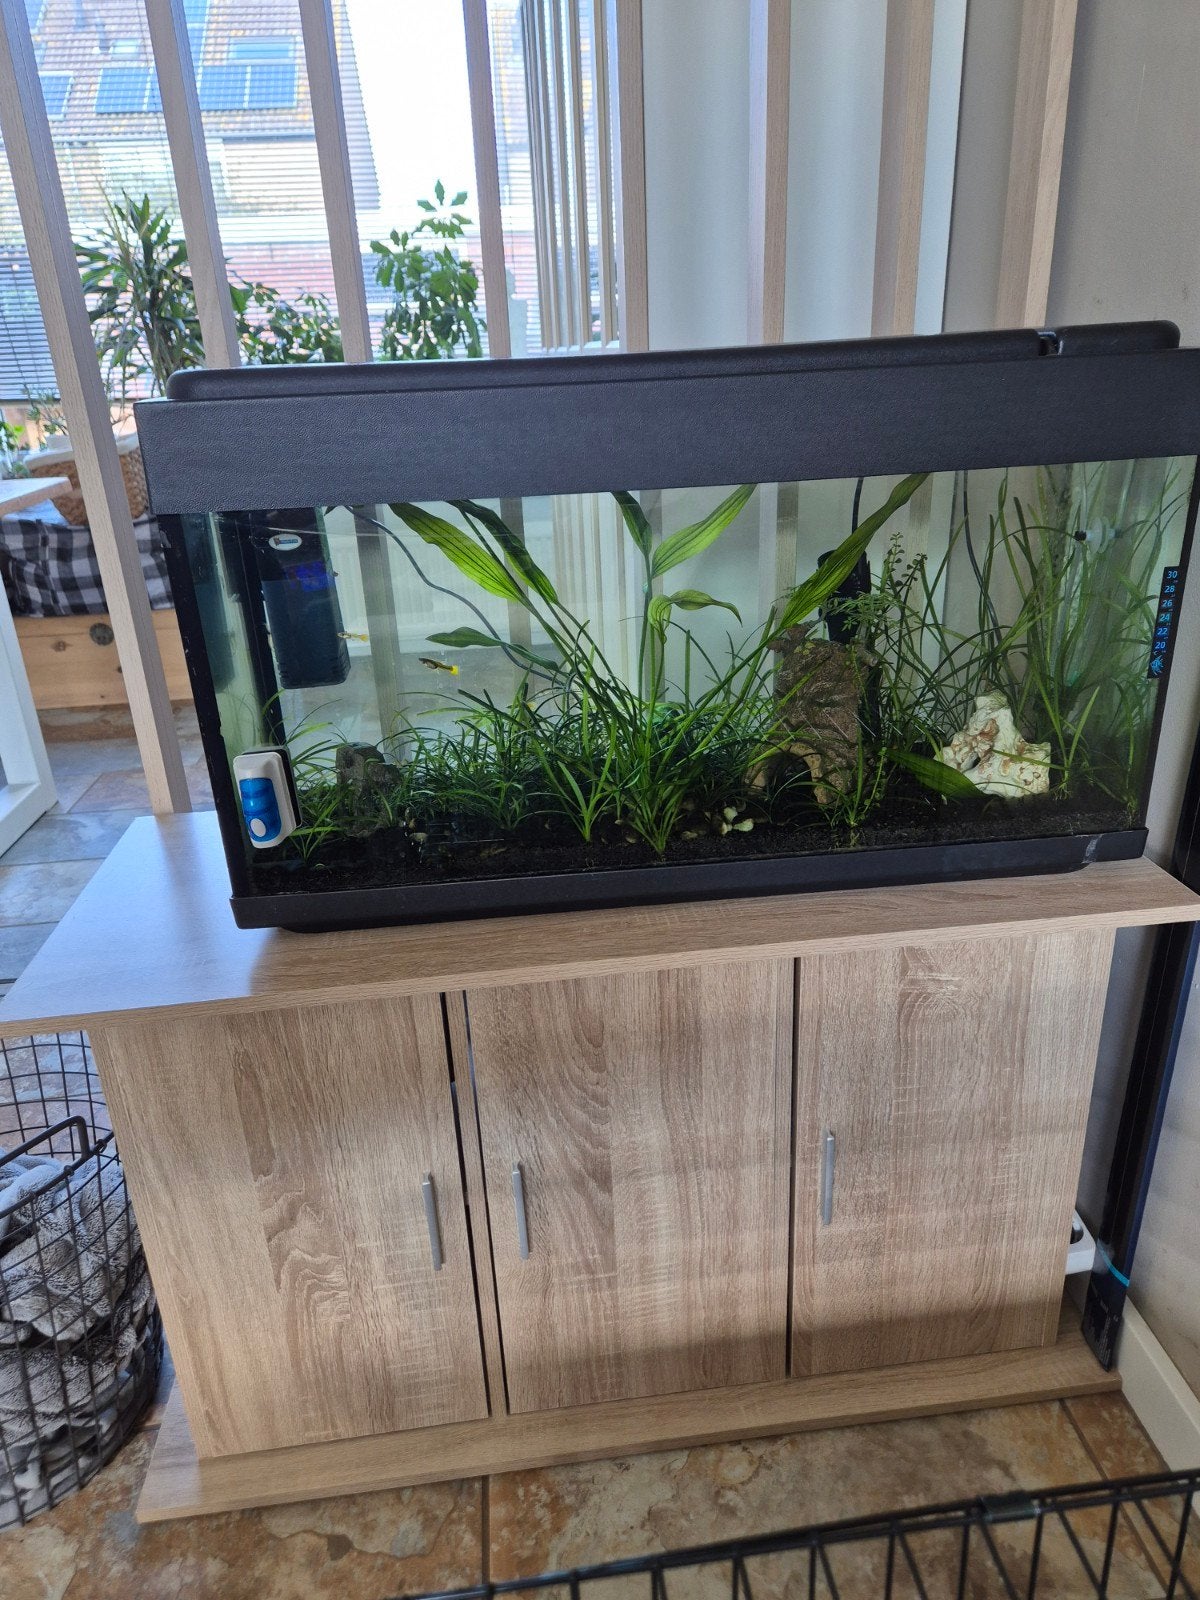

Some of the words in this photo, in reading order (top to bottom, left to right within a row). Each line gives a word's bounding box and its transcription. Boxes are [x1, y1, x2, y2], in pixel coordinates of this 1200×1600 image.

[1167, 570, 1178, 579] 30
[1164, 585, 1175, 593] 28
[1162, 600, 1173, 608] 26
[1159, 614, 1170, 622] 24
[1157, 627, 1168, 635] 22
[1155, 641, 1166, 649] 20
